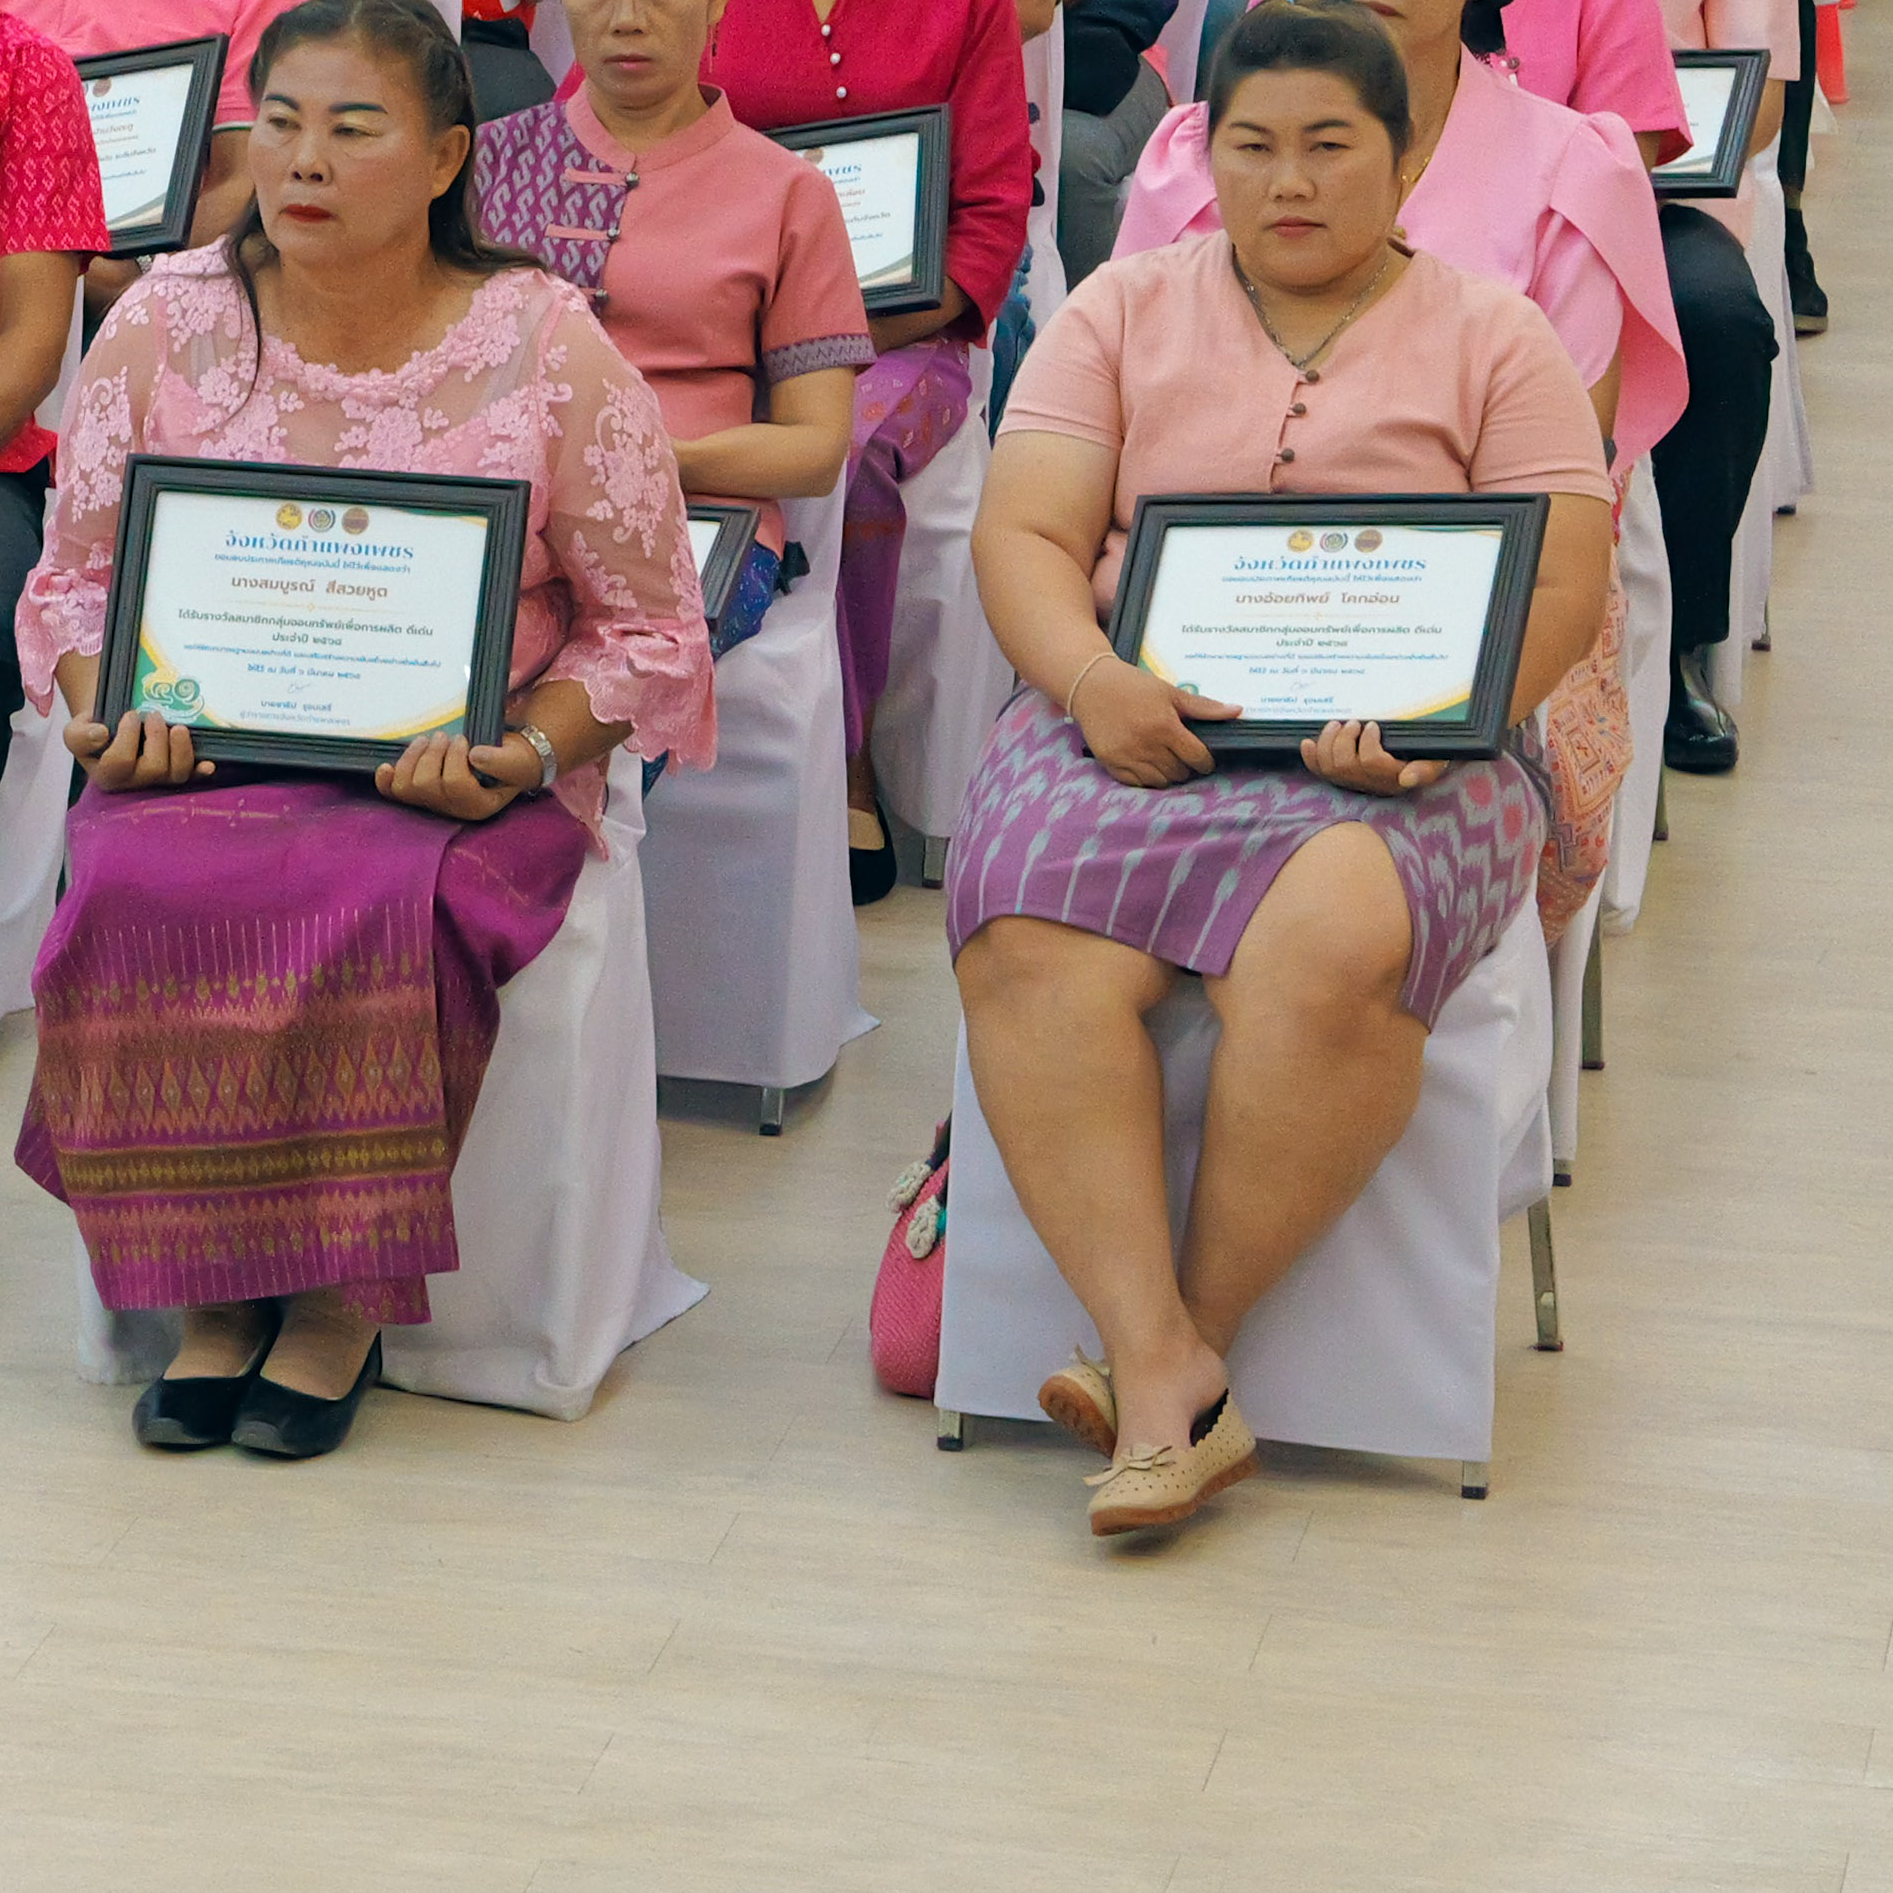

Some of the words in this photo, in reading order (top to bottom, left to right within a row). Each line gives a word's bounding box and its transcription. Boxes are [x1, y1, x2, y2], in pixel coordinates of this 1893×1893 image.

[224, 528, 415, 560] จังหวัดกำแพงเพชร
[1233, 554, 1427, 572] จังหวัดกำแพงเพชร
[230, 575, 316, 596] นางสมบูรณ์
[1340, 590, 1401, 605] โคกอ่อน
[271, 631, 309, 645] ประจำปี
[405, 623, 434, 637] ดีเด่น
